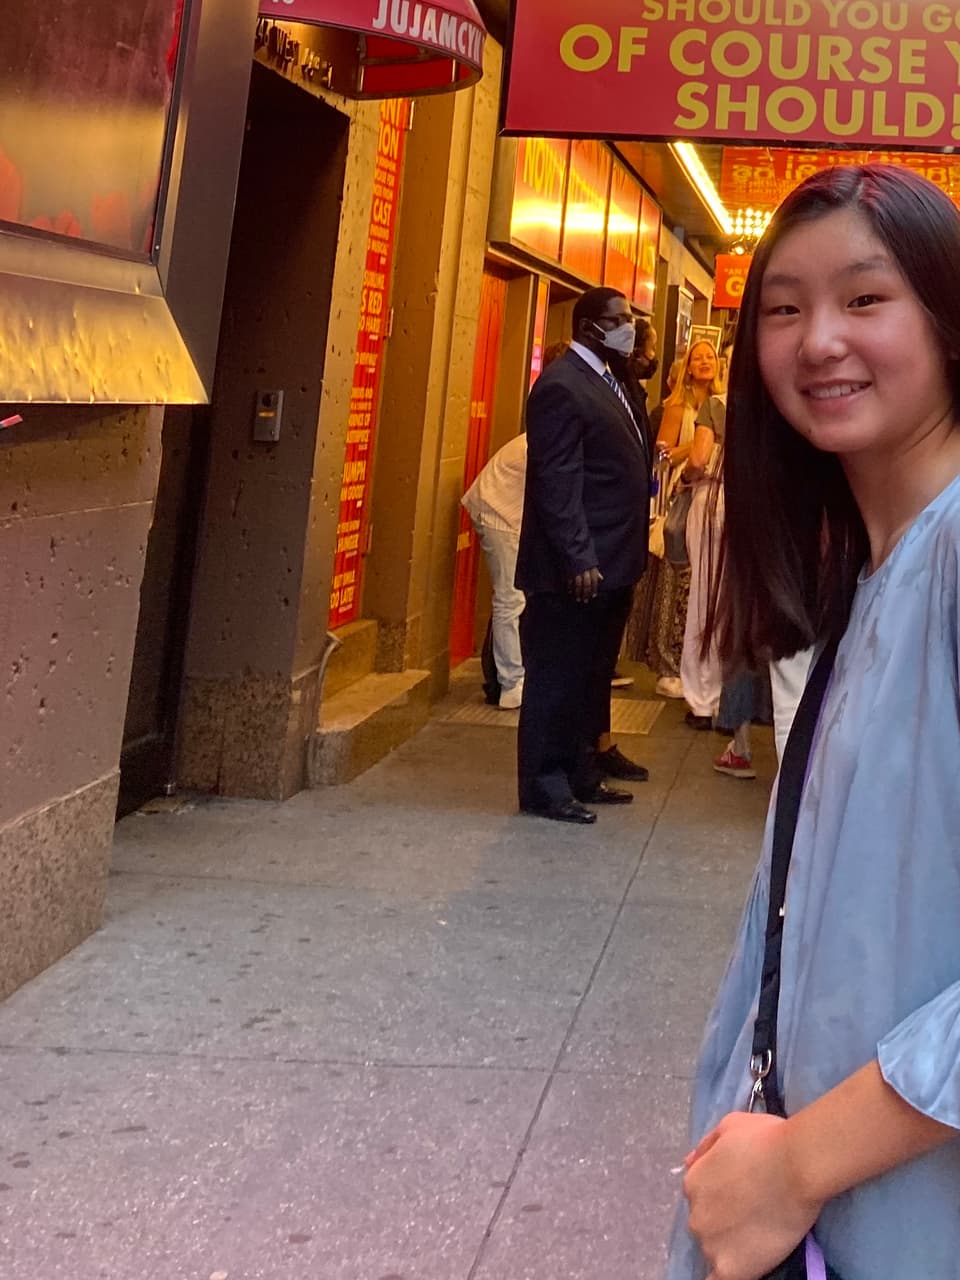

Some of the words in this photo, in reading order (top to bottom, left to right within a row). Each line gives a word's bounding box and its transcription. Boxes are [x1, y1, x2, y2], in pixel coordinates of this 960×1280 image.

[822, 0, 909, 32] YOU
[559, 23, 649, 72] OF
[669, 28, 928, 84] COURSE
[373, 198, 392, 226] CAST
